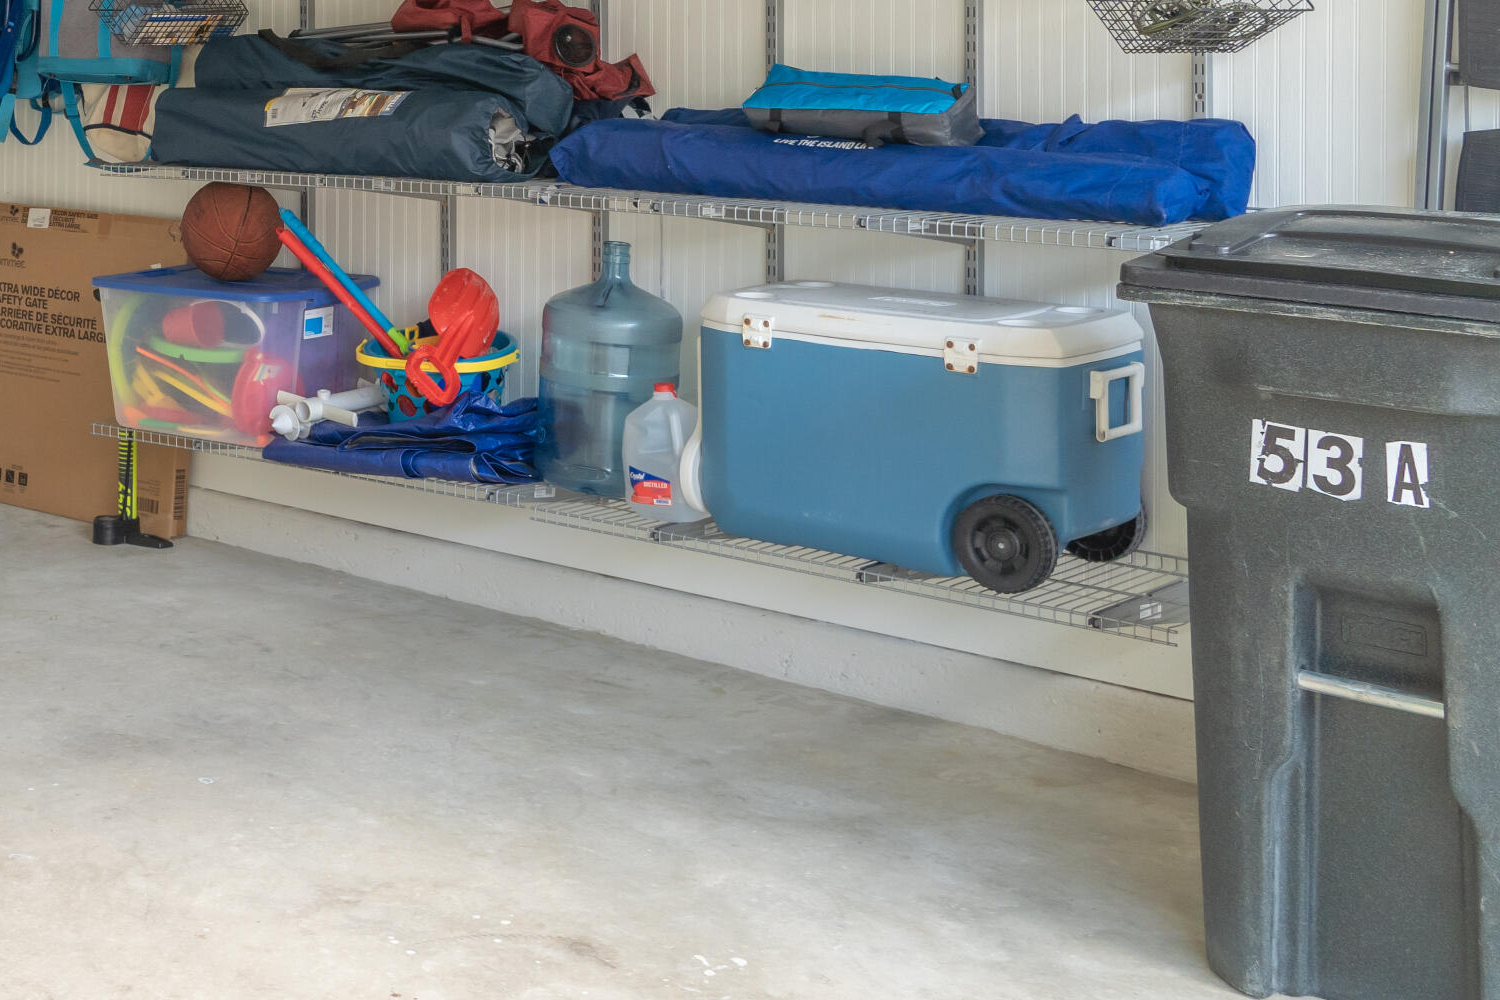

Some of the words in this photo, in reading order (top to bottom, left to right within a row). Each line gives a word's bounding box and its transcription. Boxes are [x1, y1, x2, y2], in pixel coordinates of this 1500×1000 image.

[797, 139, 819, 147] THE
[817, 140, 854, 150] ISLAND
[21, 284, 46, 298] WIDE
[47, 286, 80, 302] DÉCOR
[25, 296, 48, 310] GATE
[36, 311, 49, 323] DE
[45, 324, 75, 339] EXTRA
[1257, 424, 1356, 496] 53
[1392, 443, 1425, 506] A
